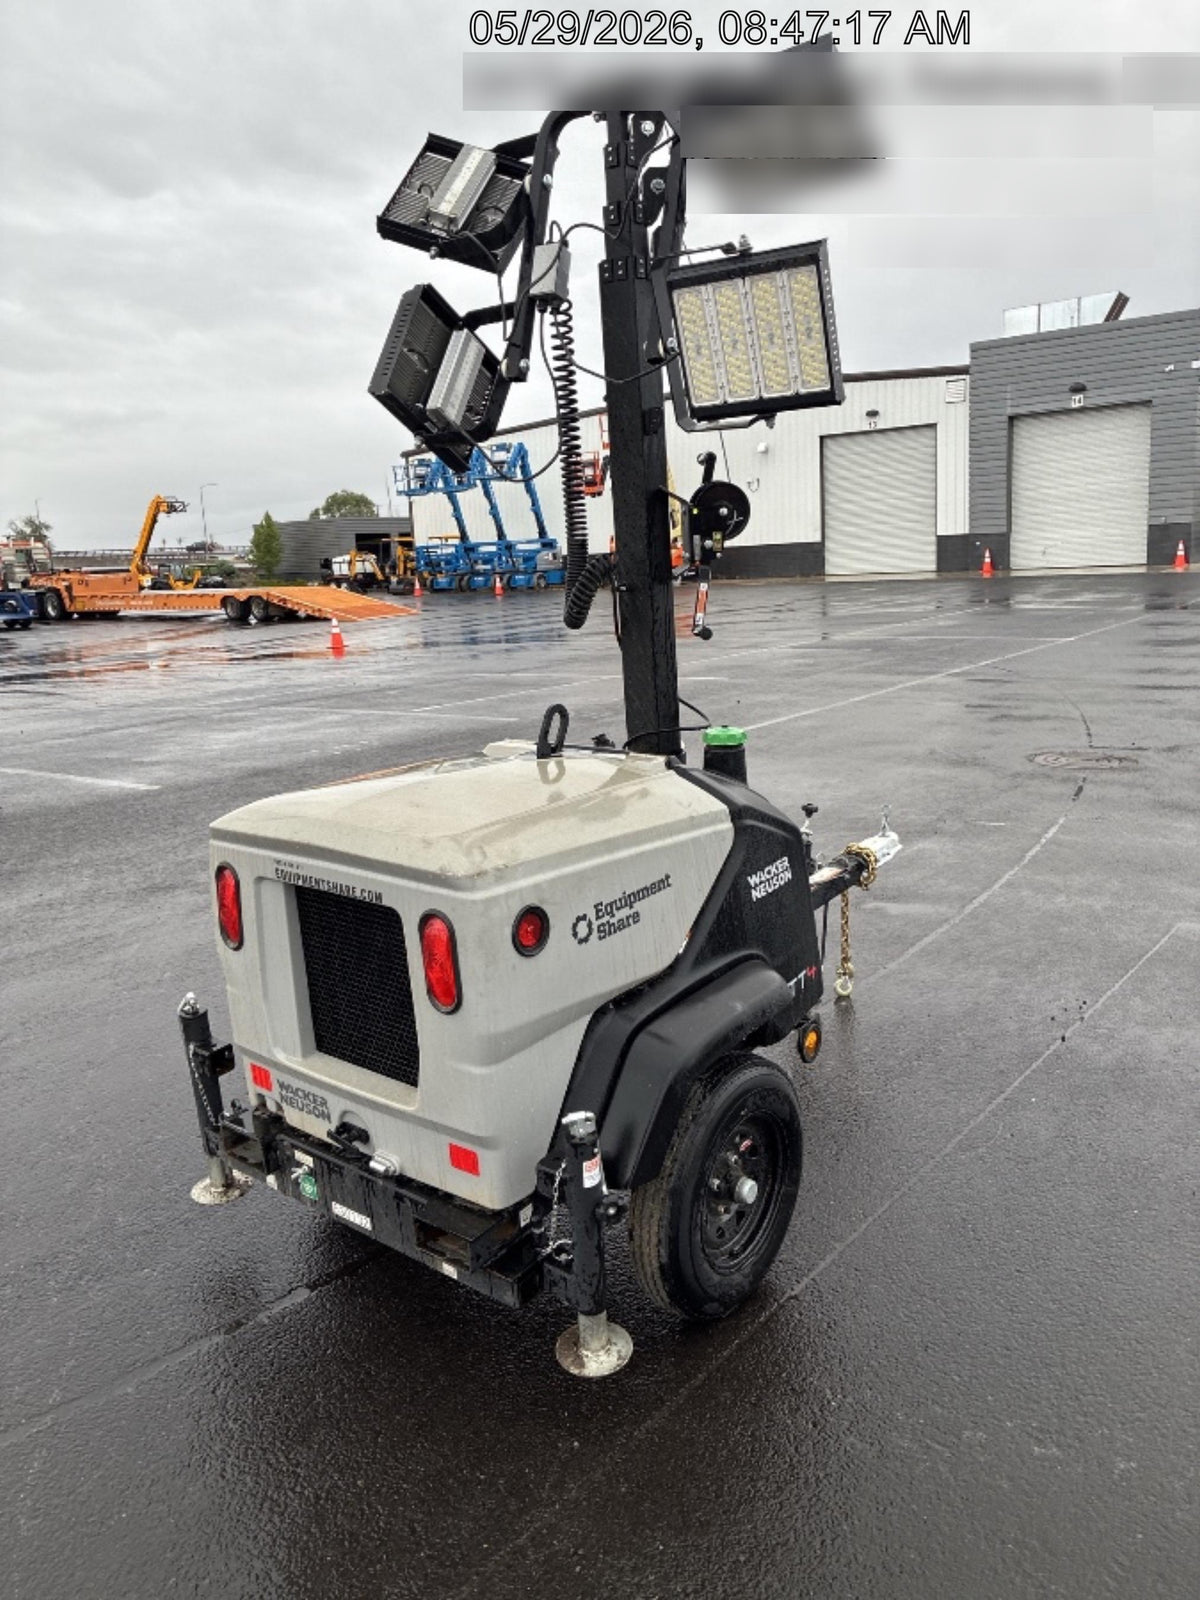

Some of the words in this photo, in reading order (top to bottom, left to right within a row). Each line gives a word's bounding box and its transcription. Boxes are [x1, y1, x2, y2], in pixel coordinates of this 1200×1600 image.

[275, 867, 384, 904] EQUIPMENTSHARE.COM
[747, 856, 790, 888] WACKER
[751, 868, 792, 902] NEUSON
[593, 873, 672, 920] Equipment
[597, 910, 641, 941] Share
[277, 1079, 328, 1109] WACKER
[280, 1094, 332, 1124] NEUSON
